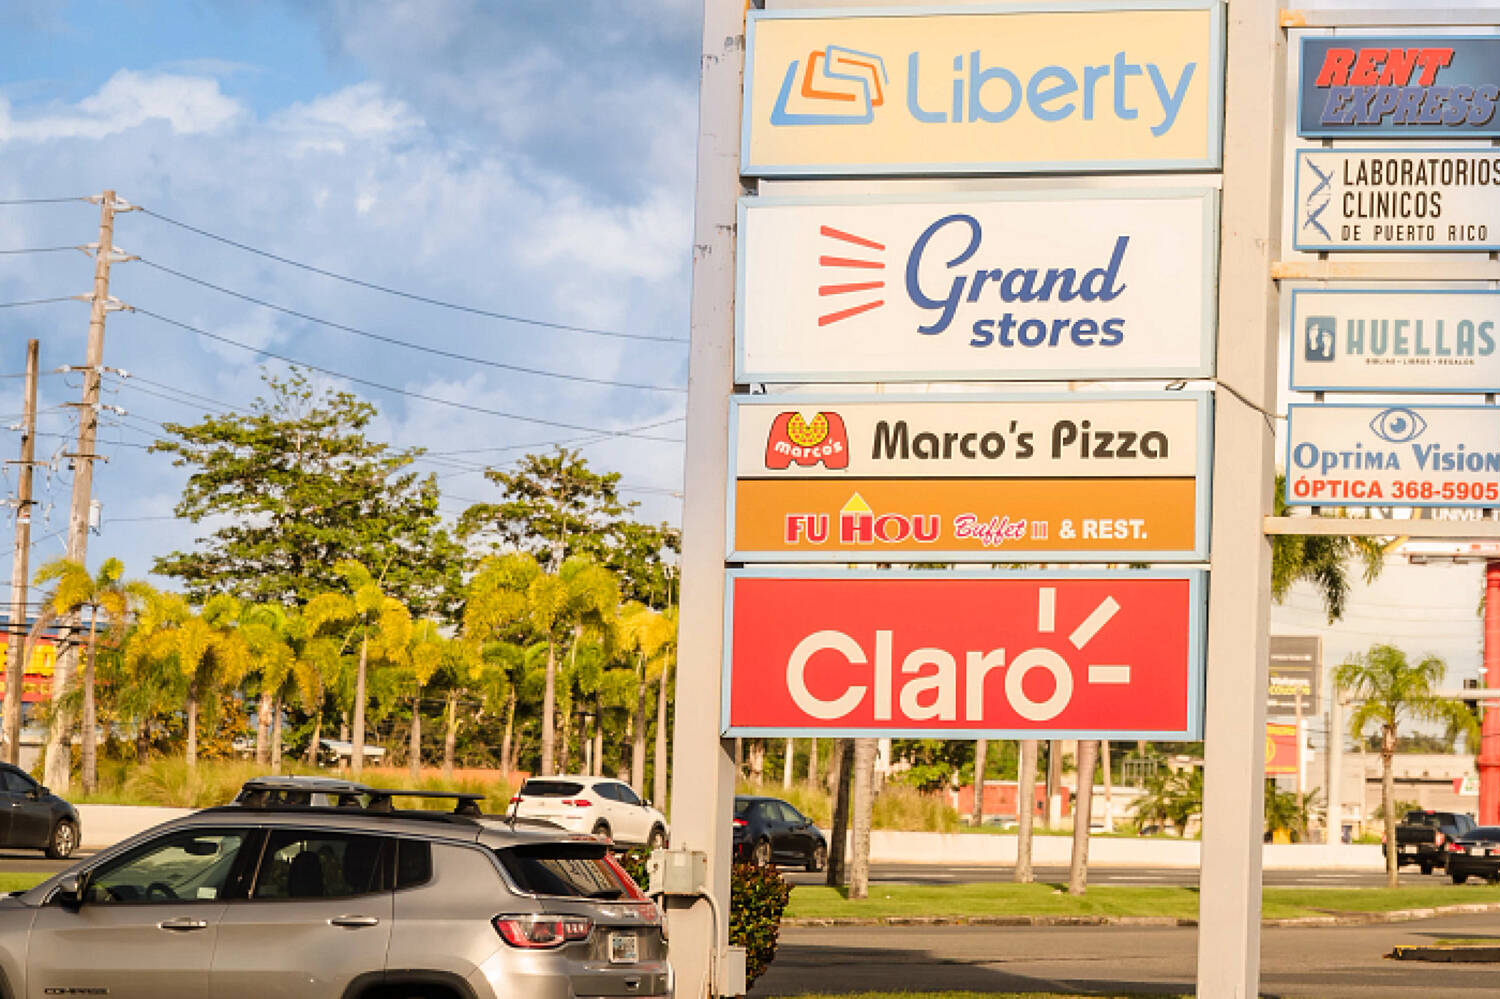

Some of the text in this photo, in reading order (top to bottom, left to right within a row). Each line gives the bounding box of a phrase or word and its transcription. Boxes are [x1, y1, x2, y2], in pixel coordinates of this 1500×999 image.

[1315, 48, 1455, 88] RENT
[907, 49, 1196, 138] Liberty
[1320, 84, 1500, 126] EXPRESS
[1343, 191, 1442, 218] CLINICOS
[1341, 225, 1488, 241] DE PUERTO RICO
[905, 213, 1131, 335] Grand
[969, 312, 1126, 347] stores
[1346, 319, 1496, 356] HUELLAS
[872, 420, 1169, 459] Marco's Pizza
[1294, 476, 1499, 500] ÓPTICA 368-5905
[784, 513, 828, 543] FU
[840, 512, 941, 543] HOU
[954, 513, 1027, 547] Buffet
[1059, 519, 1076, 539] &
[1082, 519, 1148, 540] REST.
[786, 630, 1074, 721] Claro
